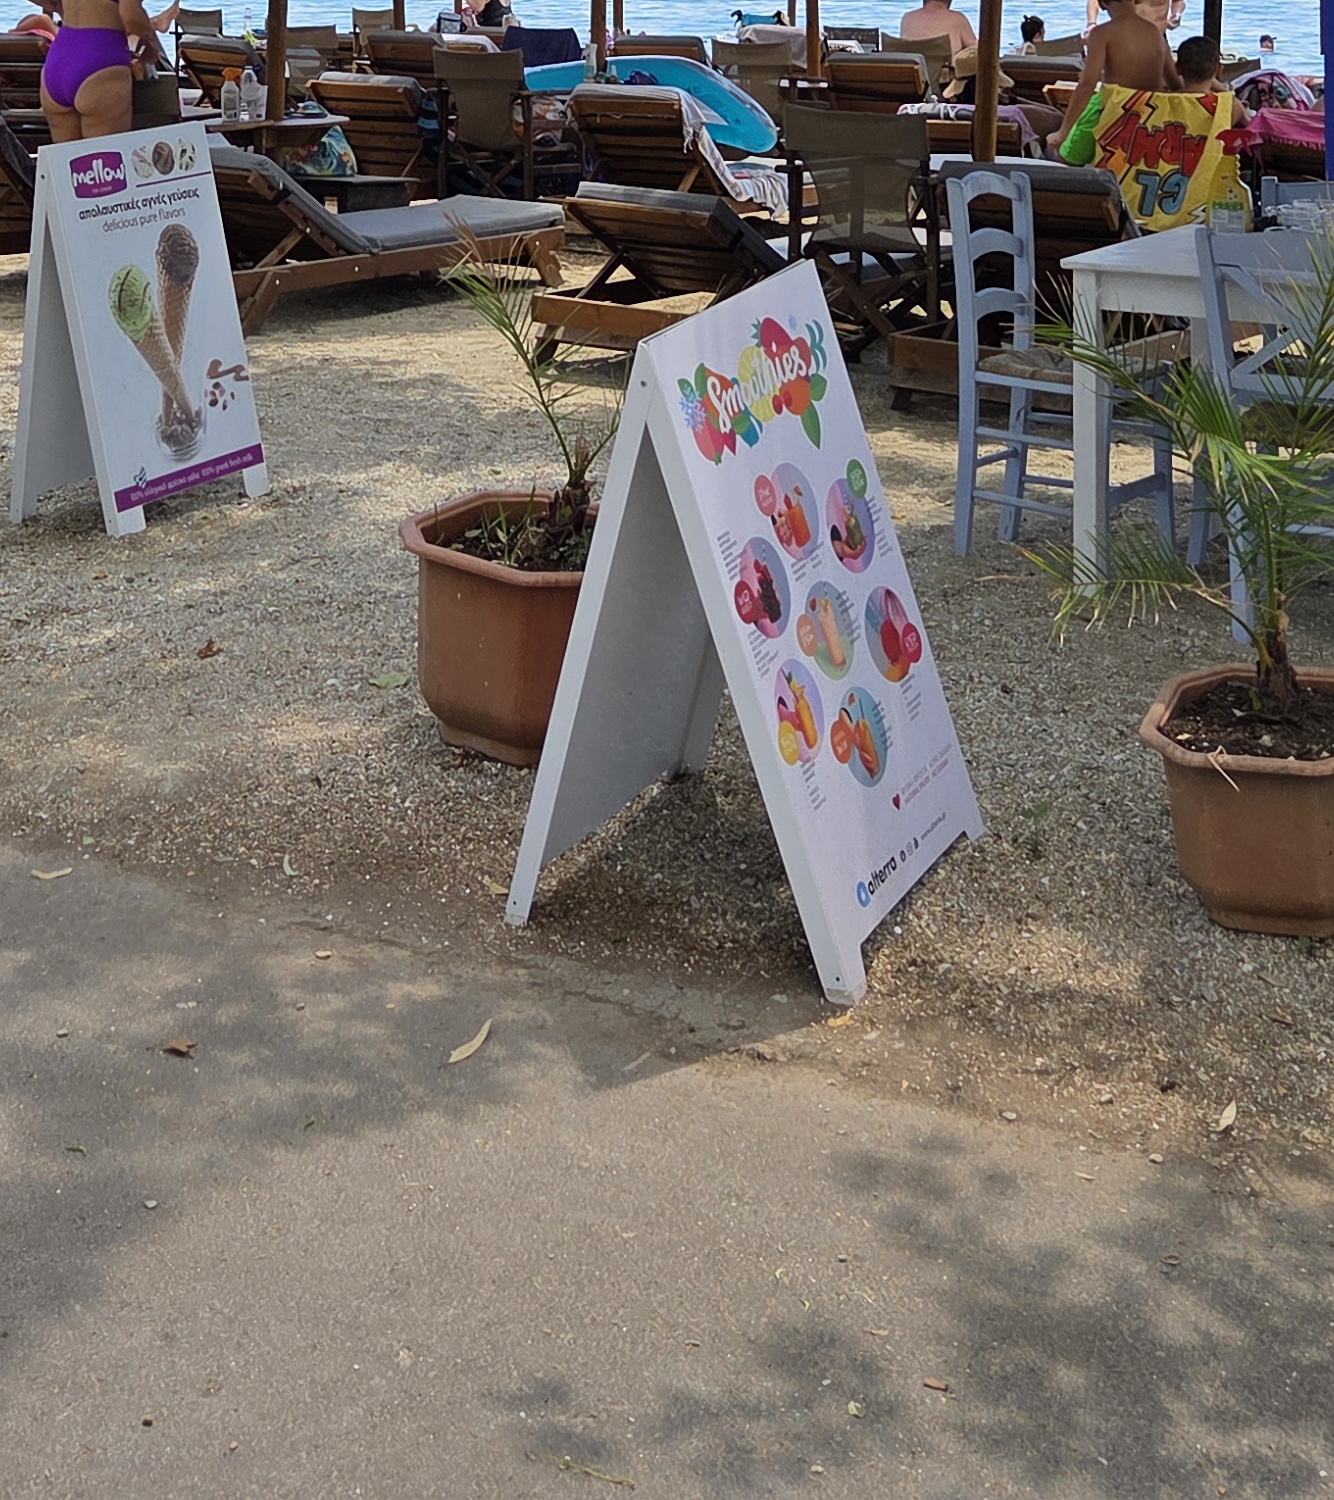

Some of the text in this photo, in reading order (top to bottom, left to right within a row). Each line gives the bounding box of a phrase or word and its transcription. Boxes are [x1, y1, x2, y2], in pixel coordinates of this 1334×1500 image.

[72, 158, 126, 188] mellow
[139, 212, 158, 228] pure
[706, 341, 807, 435] Smoothies
